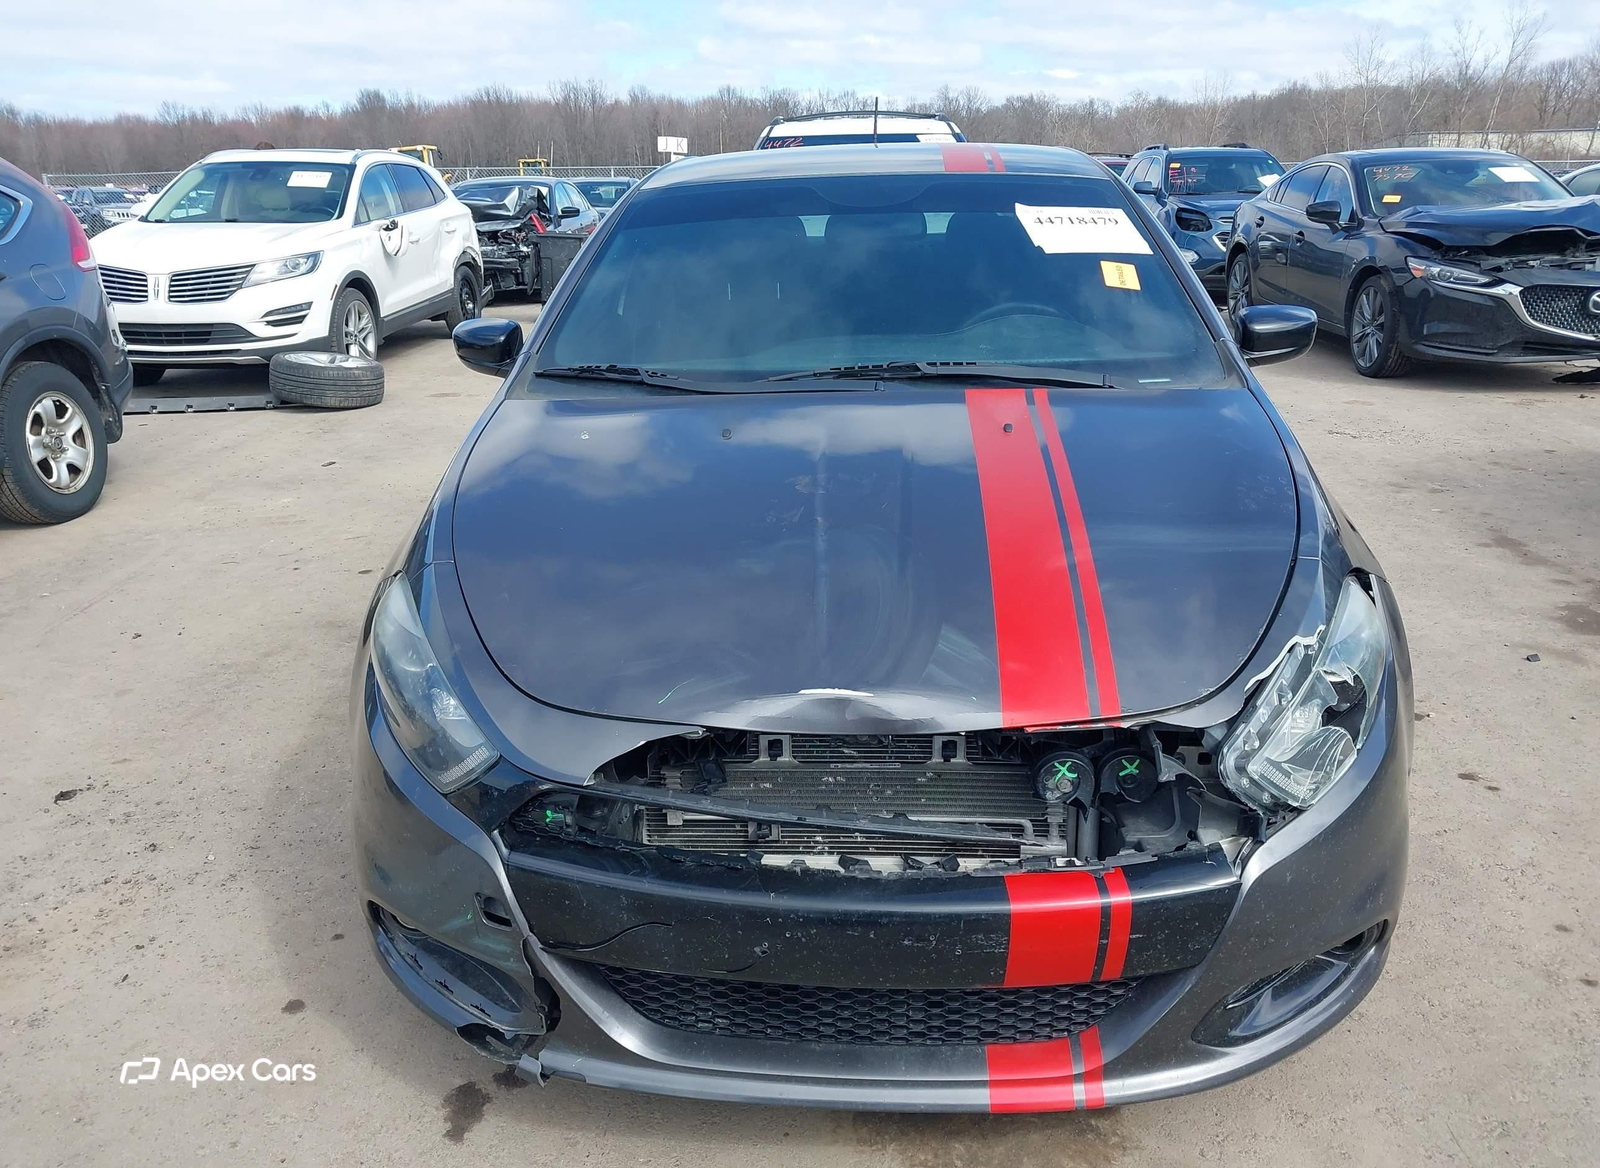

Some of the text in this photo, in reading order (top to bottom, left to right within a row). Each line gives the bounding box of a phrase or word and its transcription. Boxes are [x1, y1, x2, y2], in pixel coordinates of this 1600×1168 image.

[676, 138, 685, 152] K
[764, 137, 804, 150] 4472
[1033, 216, 1119, 226] 44718479
